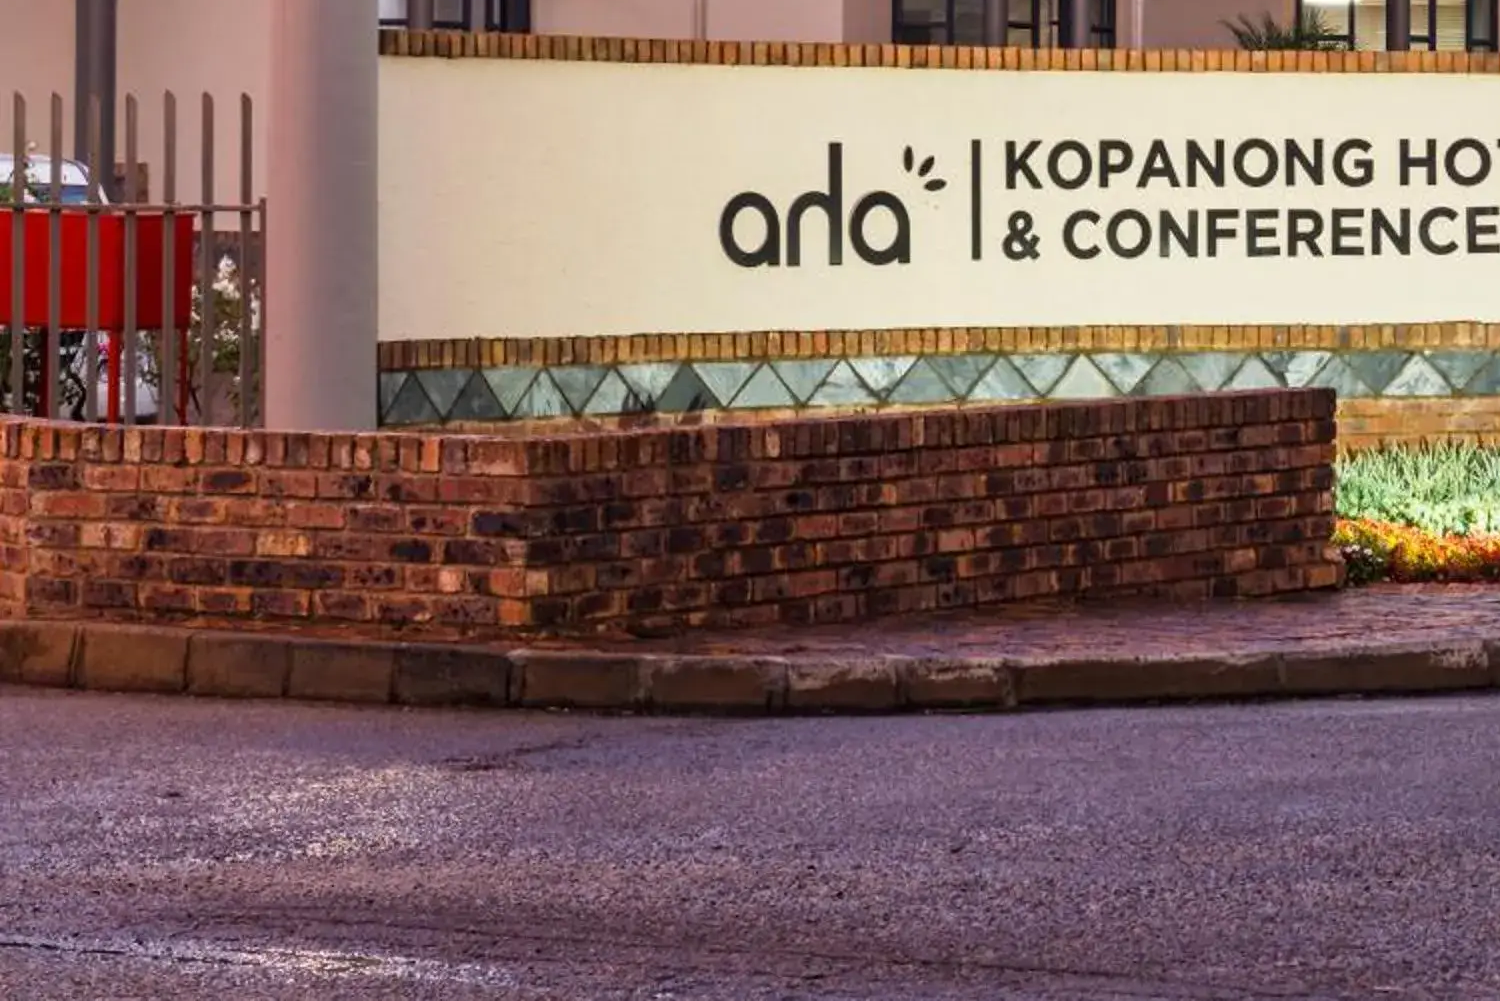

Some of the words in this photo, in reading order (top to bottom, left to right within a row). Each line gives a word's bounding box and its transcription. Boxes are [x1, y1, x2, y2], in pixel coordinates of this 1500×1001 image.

[1005, 138, 1374, 190] KOPANONG
[1002, 210, 1041, 261] &
[1062, 206, 1500, 260] CONFERENCE
